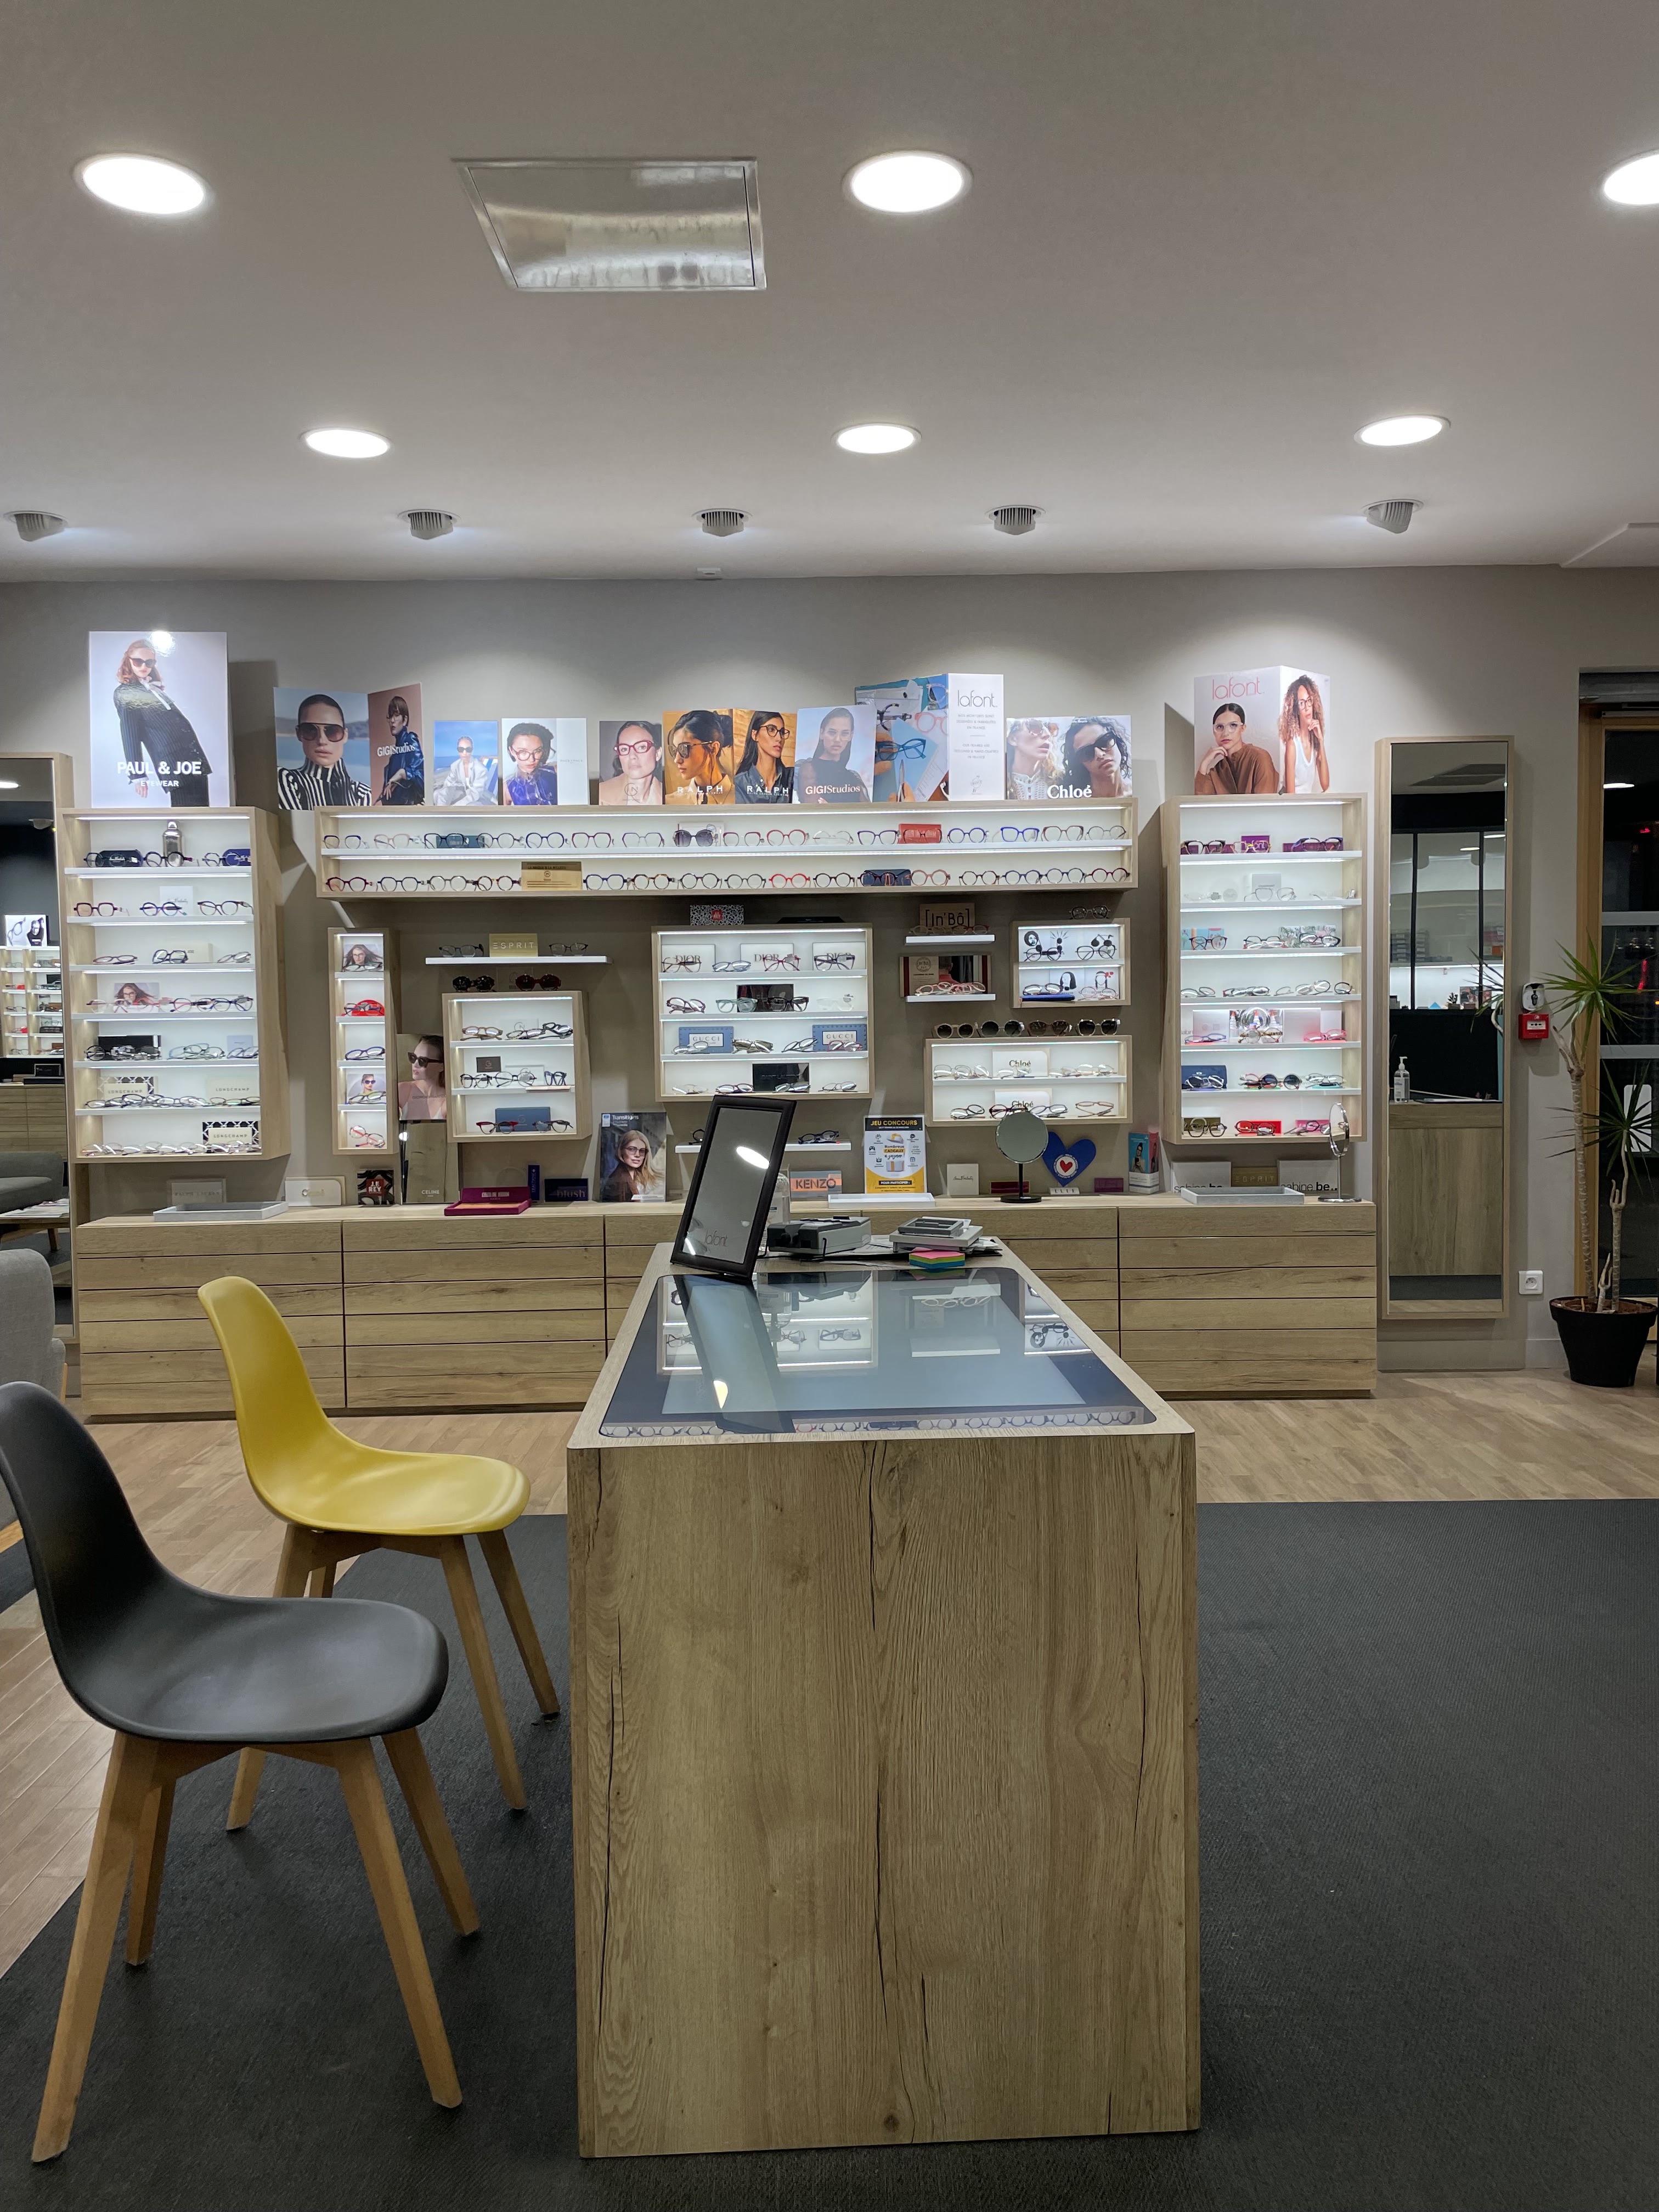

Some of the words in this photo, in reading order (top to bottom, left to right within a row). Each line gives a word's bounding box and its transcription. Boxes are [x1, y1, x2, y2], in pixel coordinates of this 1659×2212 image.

[1212, 677, 1262, 700] lafont
[957, 690, 996, 708] lafont
[377, 742, 416, 757] GIGIStudios
[117, 761, 154, 775] PAUL
[158, 761, 171, 775] &
[173, 761, 202, 775] JOE
[677, 785, 723, 793] RALPH
[747, 785, 789, 794] RALPH
[805, 784, 861, 795] GIGIStudios
[1047, 785, 1092, 799] Chloé
[754, 953, 779, 962] DIOR
[795, 1178, 836, 1189] KENZO
[556, 1189, 585, 1198] blush
[704, 1229, 729, 1248] lafont
